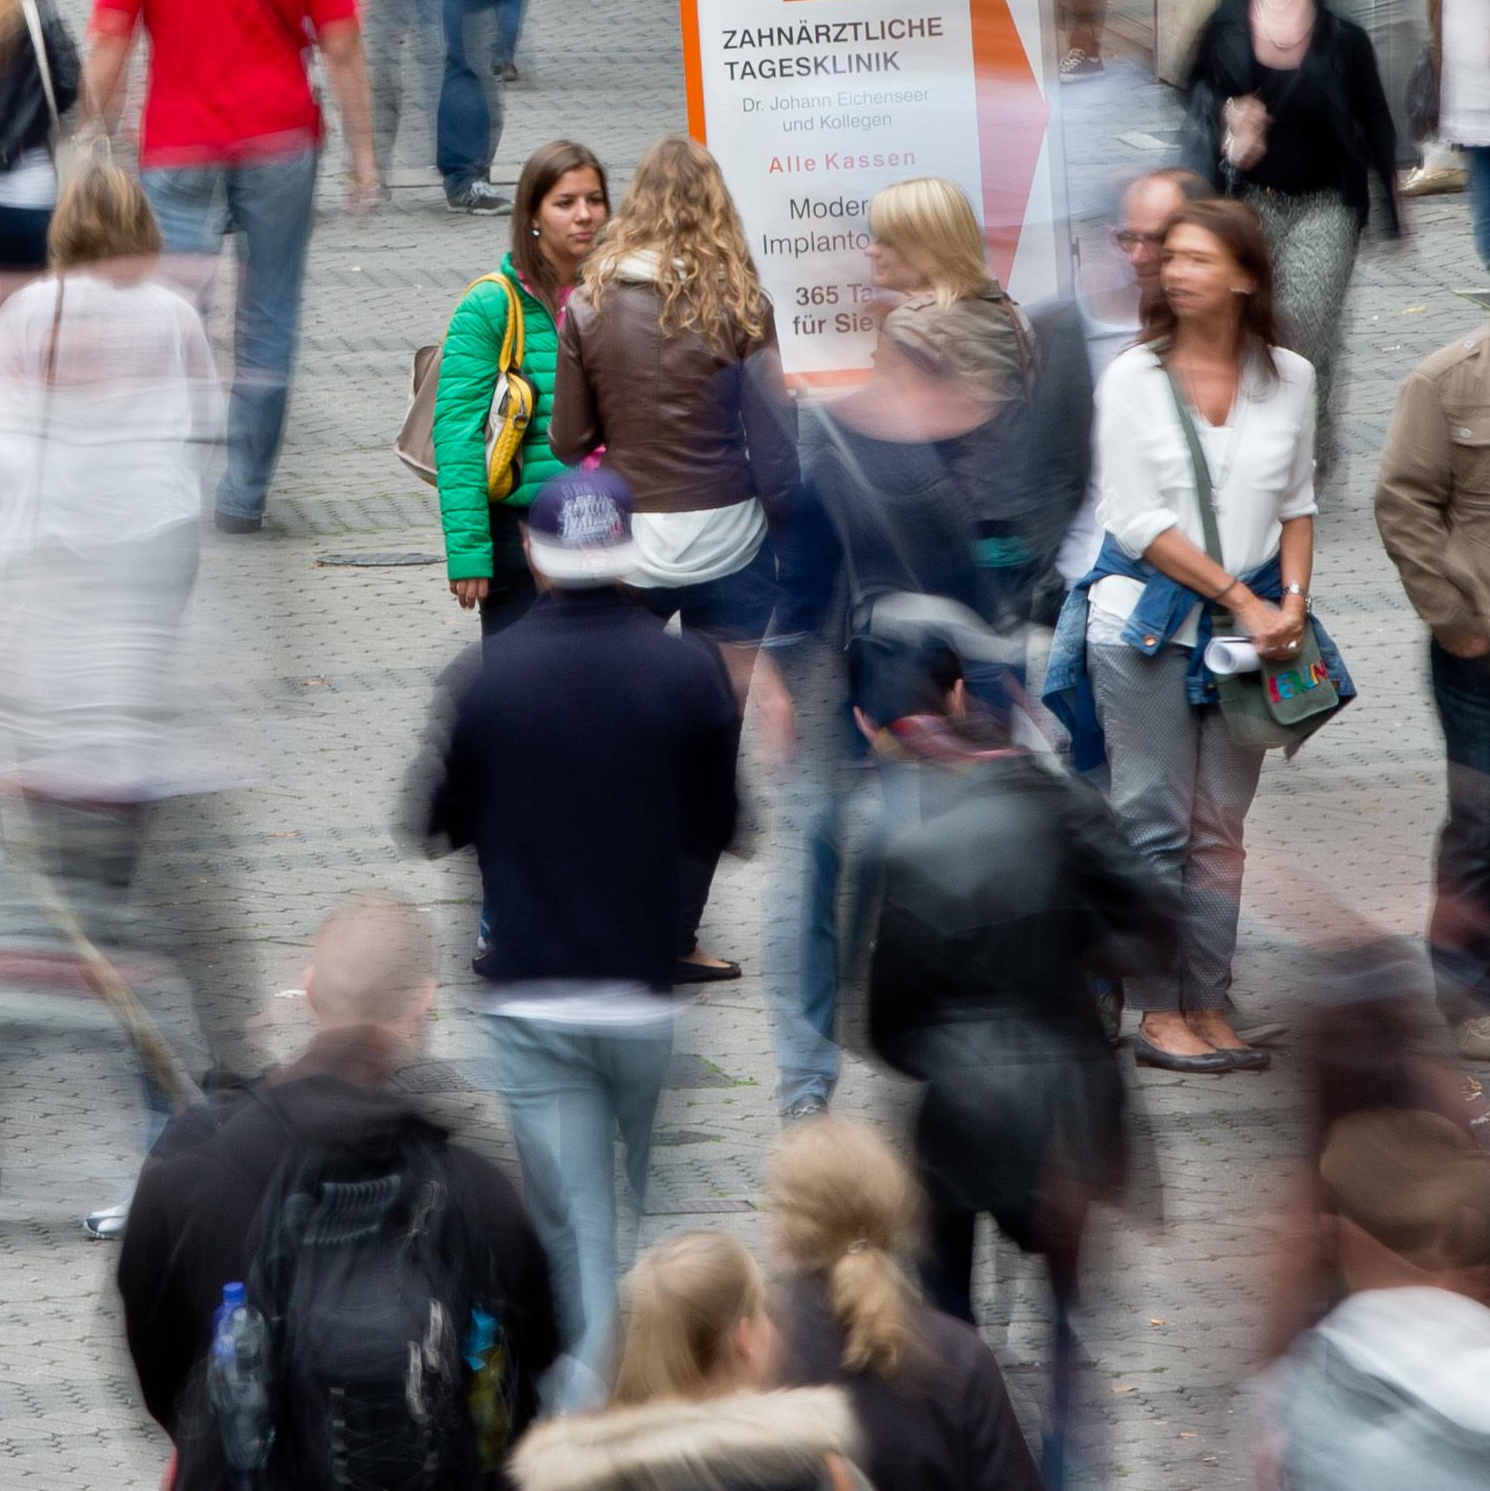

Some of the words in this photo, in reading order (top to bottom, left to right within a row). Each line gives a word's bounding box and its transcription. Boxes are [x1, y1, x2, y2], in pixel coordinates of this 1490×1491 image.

[722, 16, 944, 50] ZAHNÄRZTLICHE
[724, 51, 901, 83] TAGESKLINIK
[742, 96, 764, 114] Dr.
[769, 92, 833, 111] Johann
[837, 86, 930, 109] Eichenseer
[782, 115, 814, 133] und
[820, 111, 893, 135] Kollegen
[768, 156, 817, 174] Alle
[824, 148, 917, 171] Kassen
[790, 196, 870, 220] Moder
[762, 229, 871, 259] Implanto
[795, 285, 840, 306] 365
[847, 283, 873, 304] Ta
[792, 315, 827, 336] für
[834, 313, 874, 334] Sie
